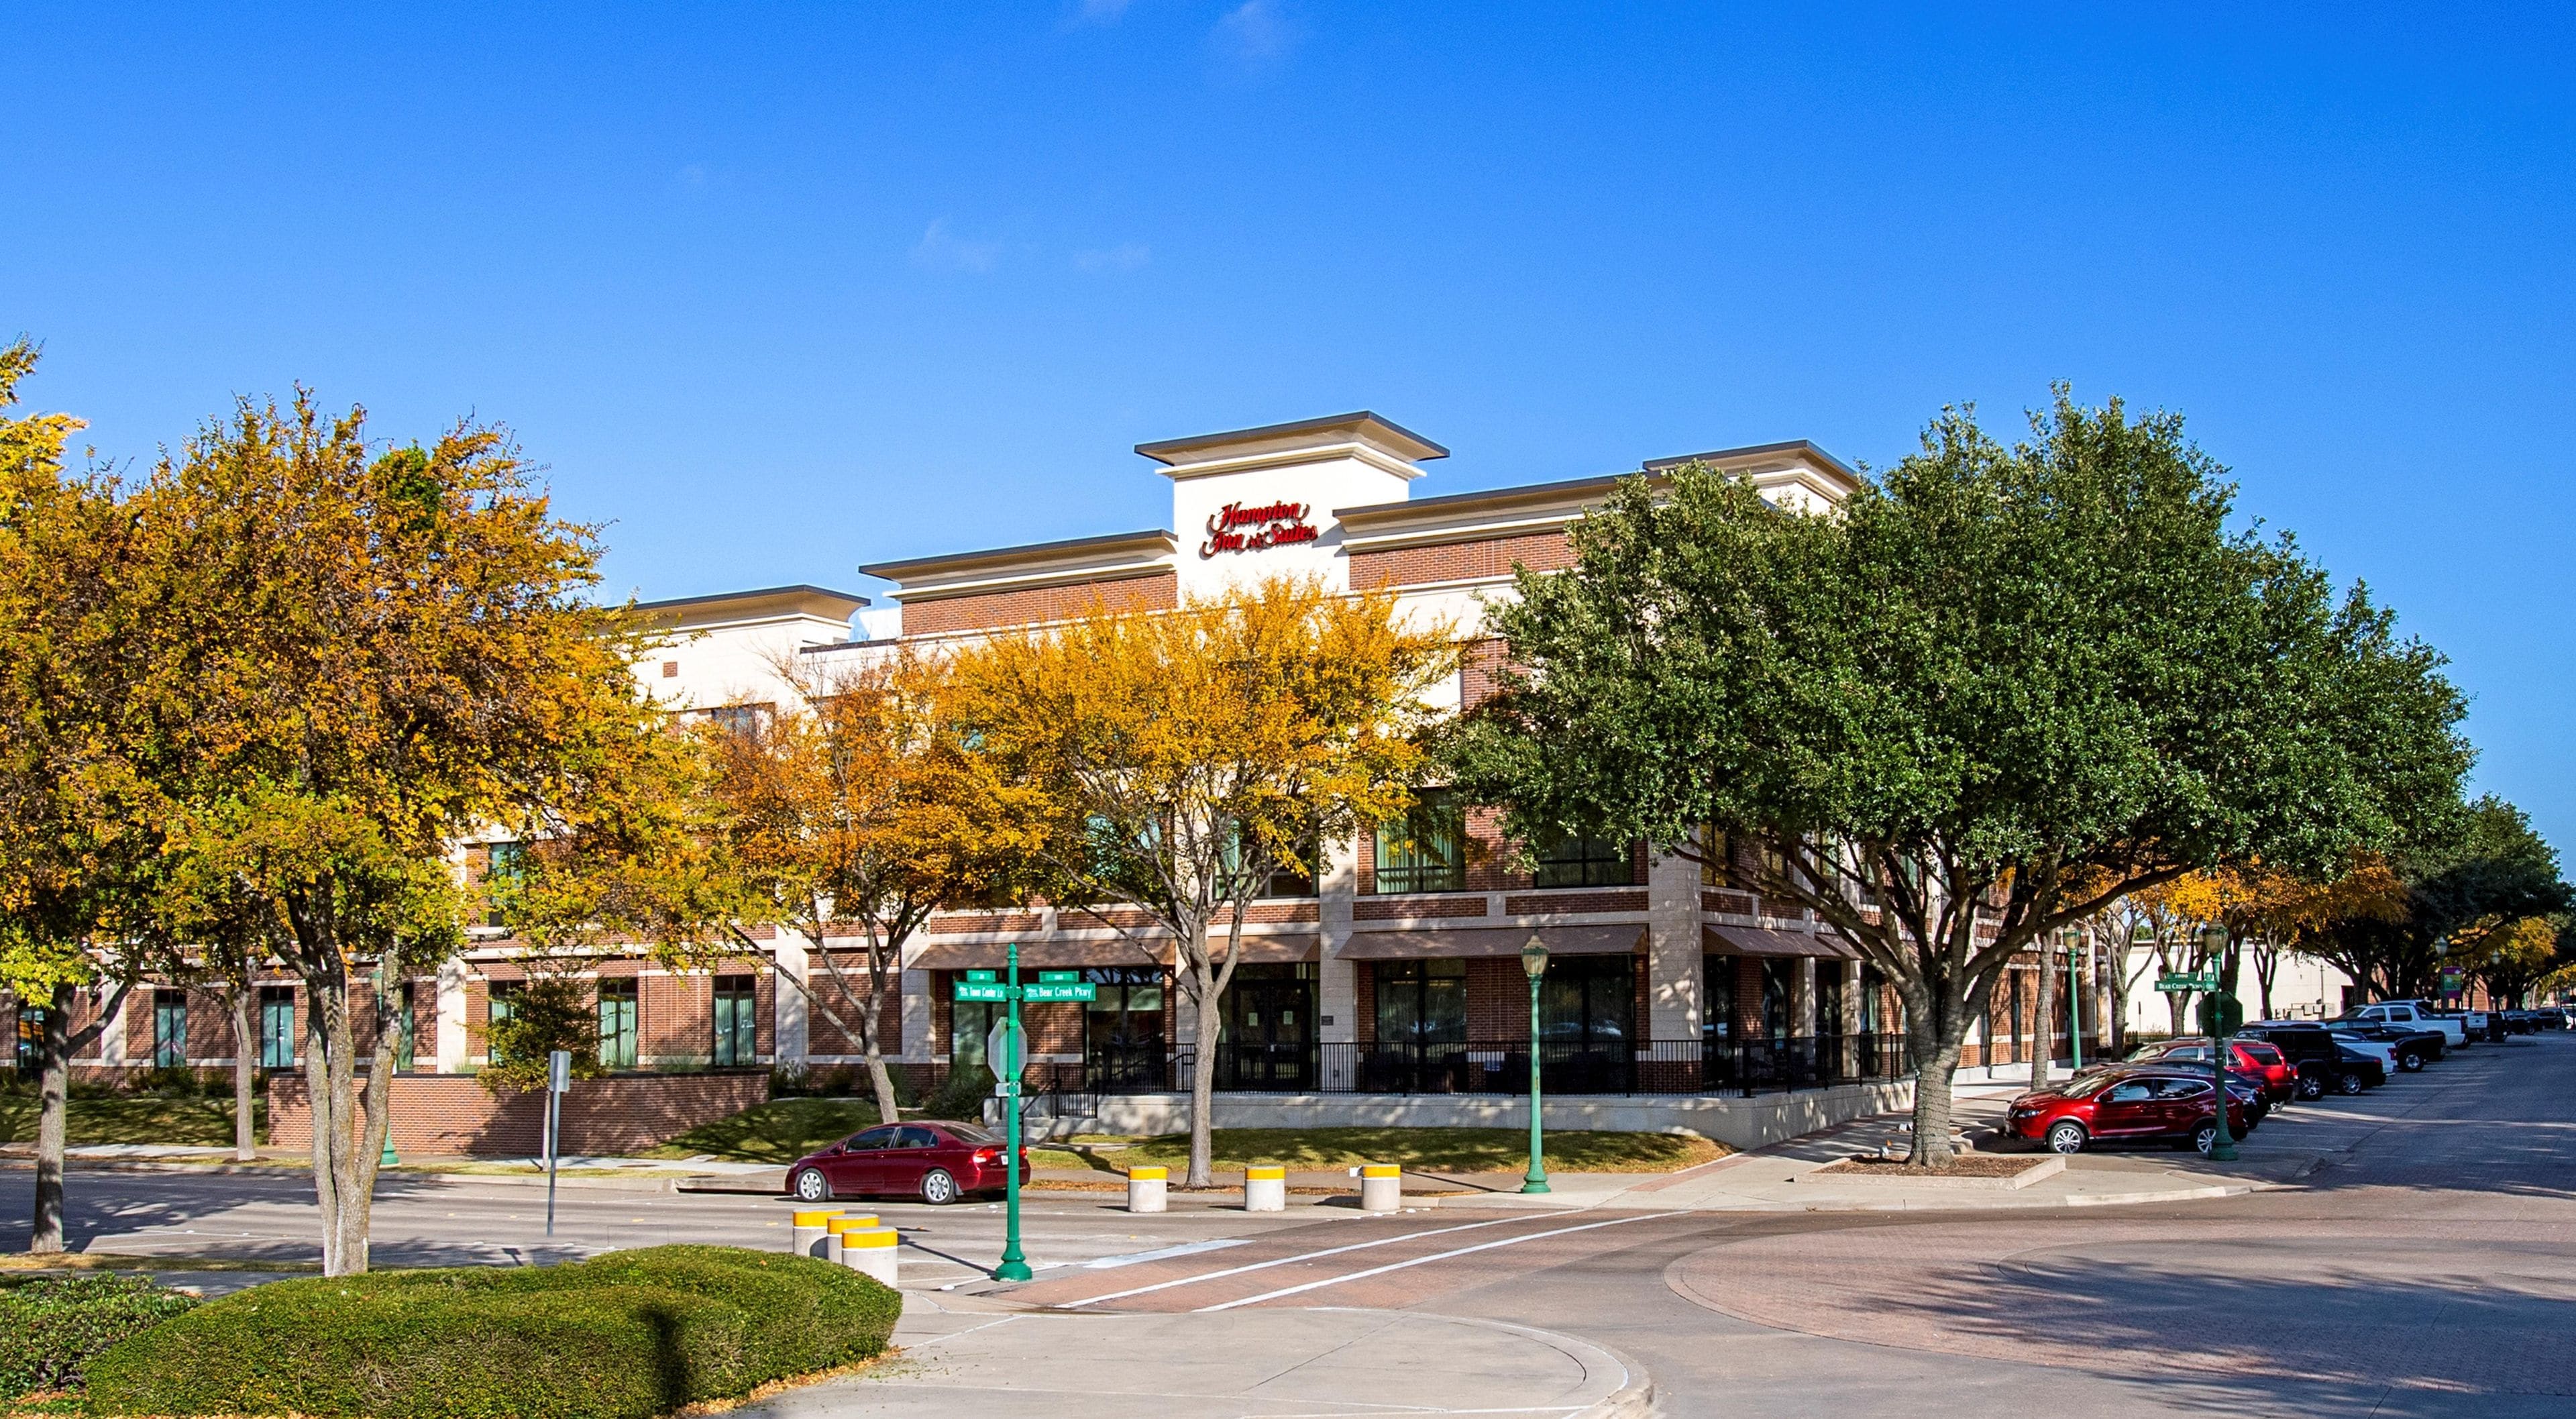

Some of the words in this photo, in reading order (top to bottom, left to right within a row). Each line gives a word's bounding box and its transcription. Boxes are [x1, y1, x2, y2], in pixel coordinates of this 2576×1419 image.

[1209, 501, 1311, 533] Hampton
[1202, 531, 1246, 557] Inn
[1264, 522, 1318, 546] Suites
[969, 986, 981, 996] Town
[982, 987, 996, 998] Center
[997, 988, 1003, 998] Ln
[1039, 987, 1053, 997] Bear
[1055, 987, 1073, 997] Creek
[1075, 987, 1091, 998] Pkwy
